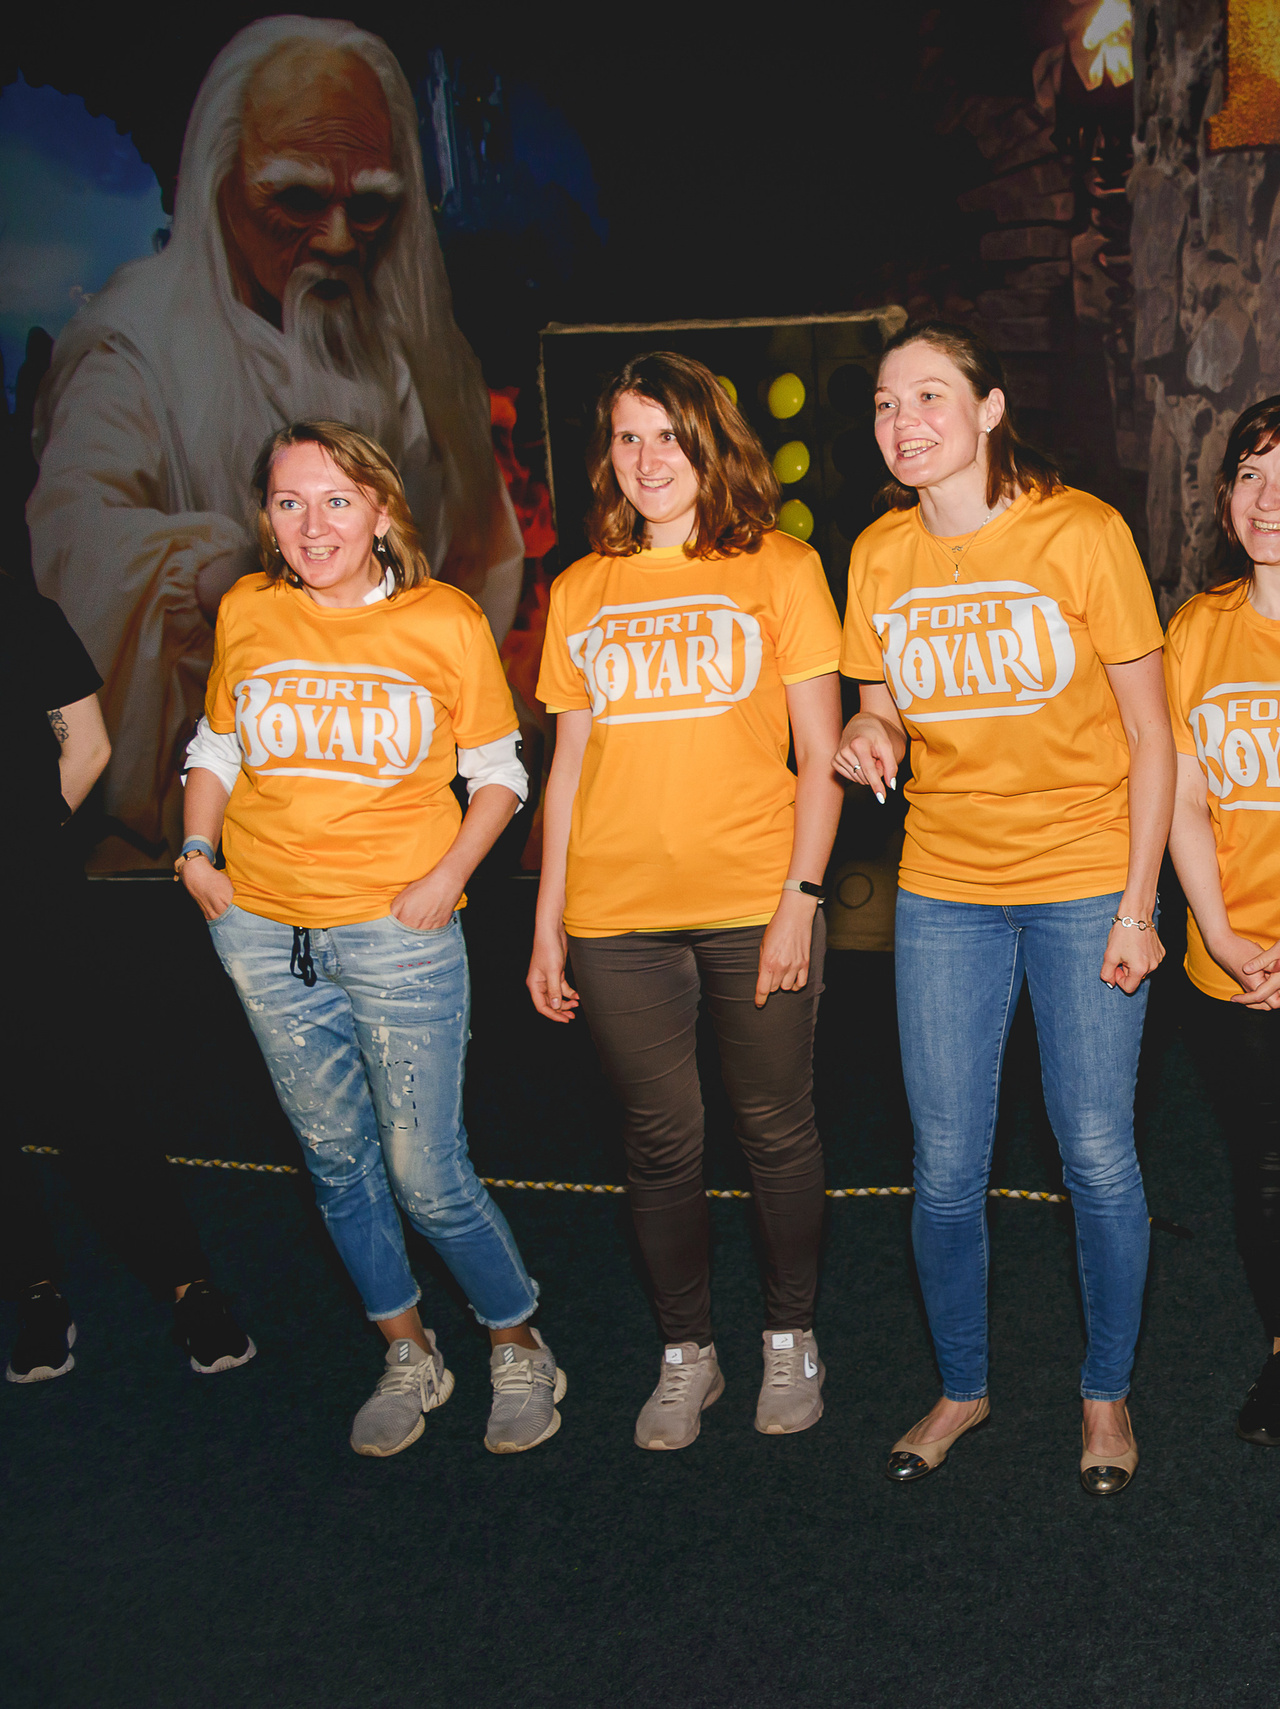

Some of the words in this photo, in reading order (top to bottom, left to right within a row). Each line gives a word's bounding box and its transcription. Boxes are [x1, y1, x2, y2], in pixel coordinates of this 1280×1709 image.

[605, 610, 705, 640] FORT
[909, 599, 1003, 631] FORT
[871, 595, 1077, 711] BOYARD
[273, 676, 380, 702] FORT
[233, 677, 437, 776] BOYARD
